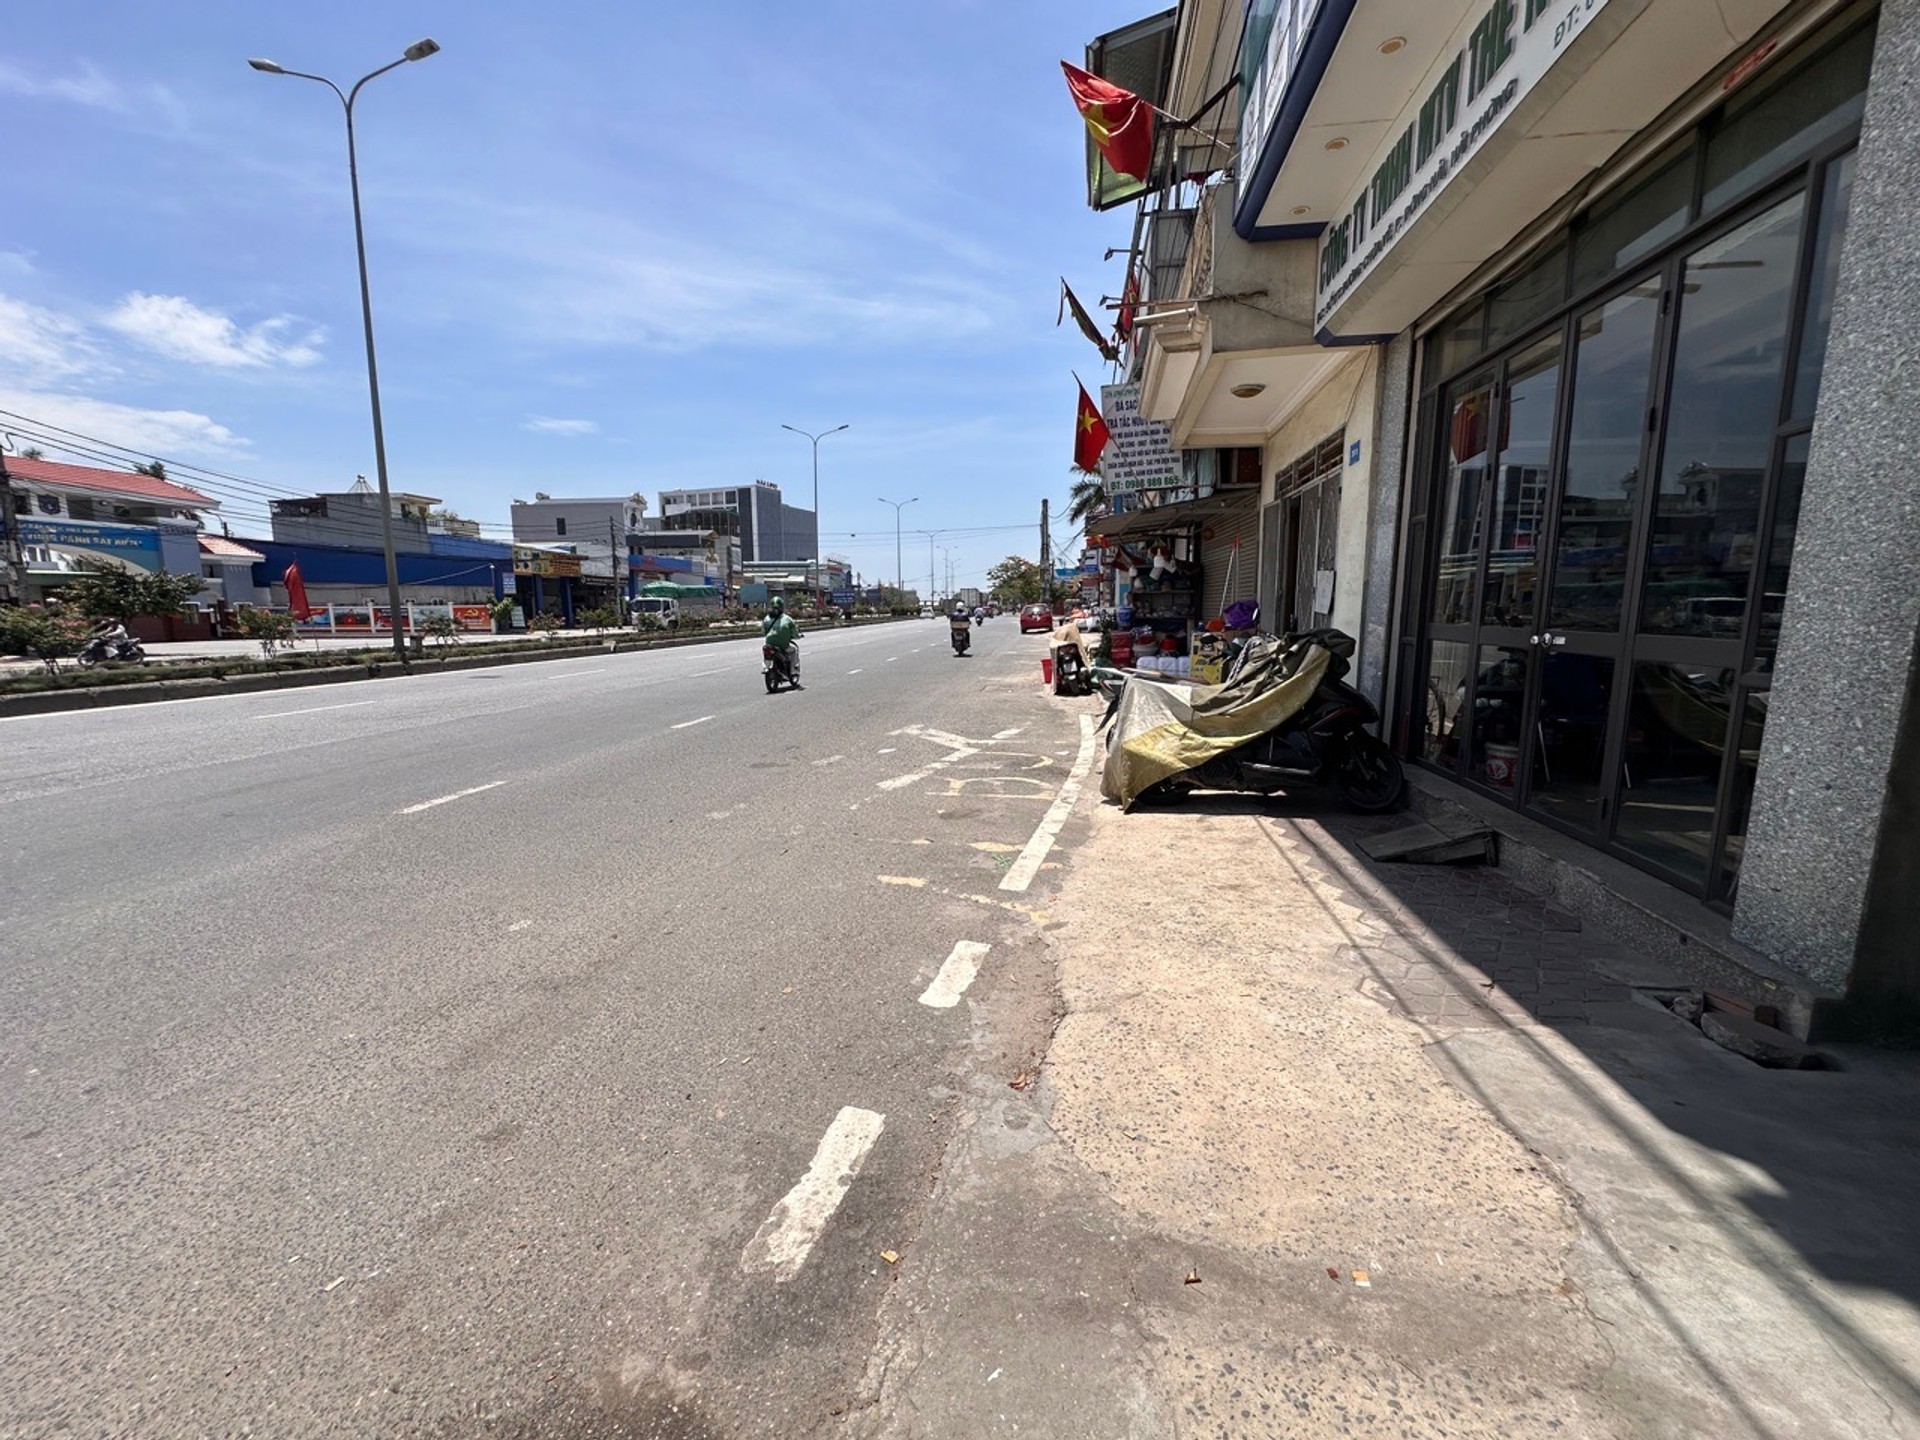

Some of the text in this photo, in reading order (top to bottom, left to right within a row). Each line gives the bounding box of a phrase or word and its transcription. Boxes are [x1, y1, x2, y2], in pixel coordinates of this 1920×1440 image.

[1319, 214, 1351, 295] CÔNG
[1352, 184, 1370, 254] TY
[1371, 120, 1416, 231] TNHH
[1415, 48, 1466, 174] MTV
[1470, 78, 1519, 145] PHÒNG
